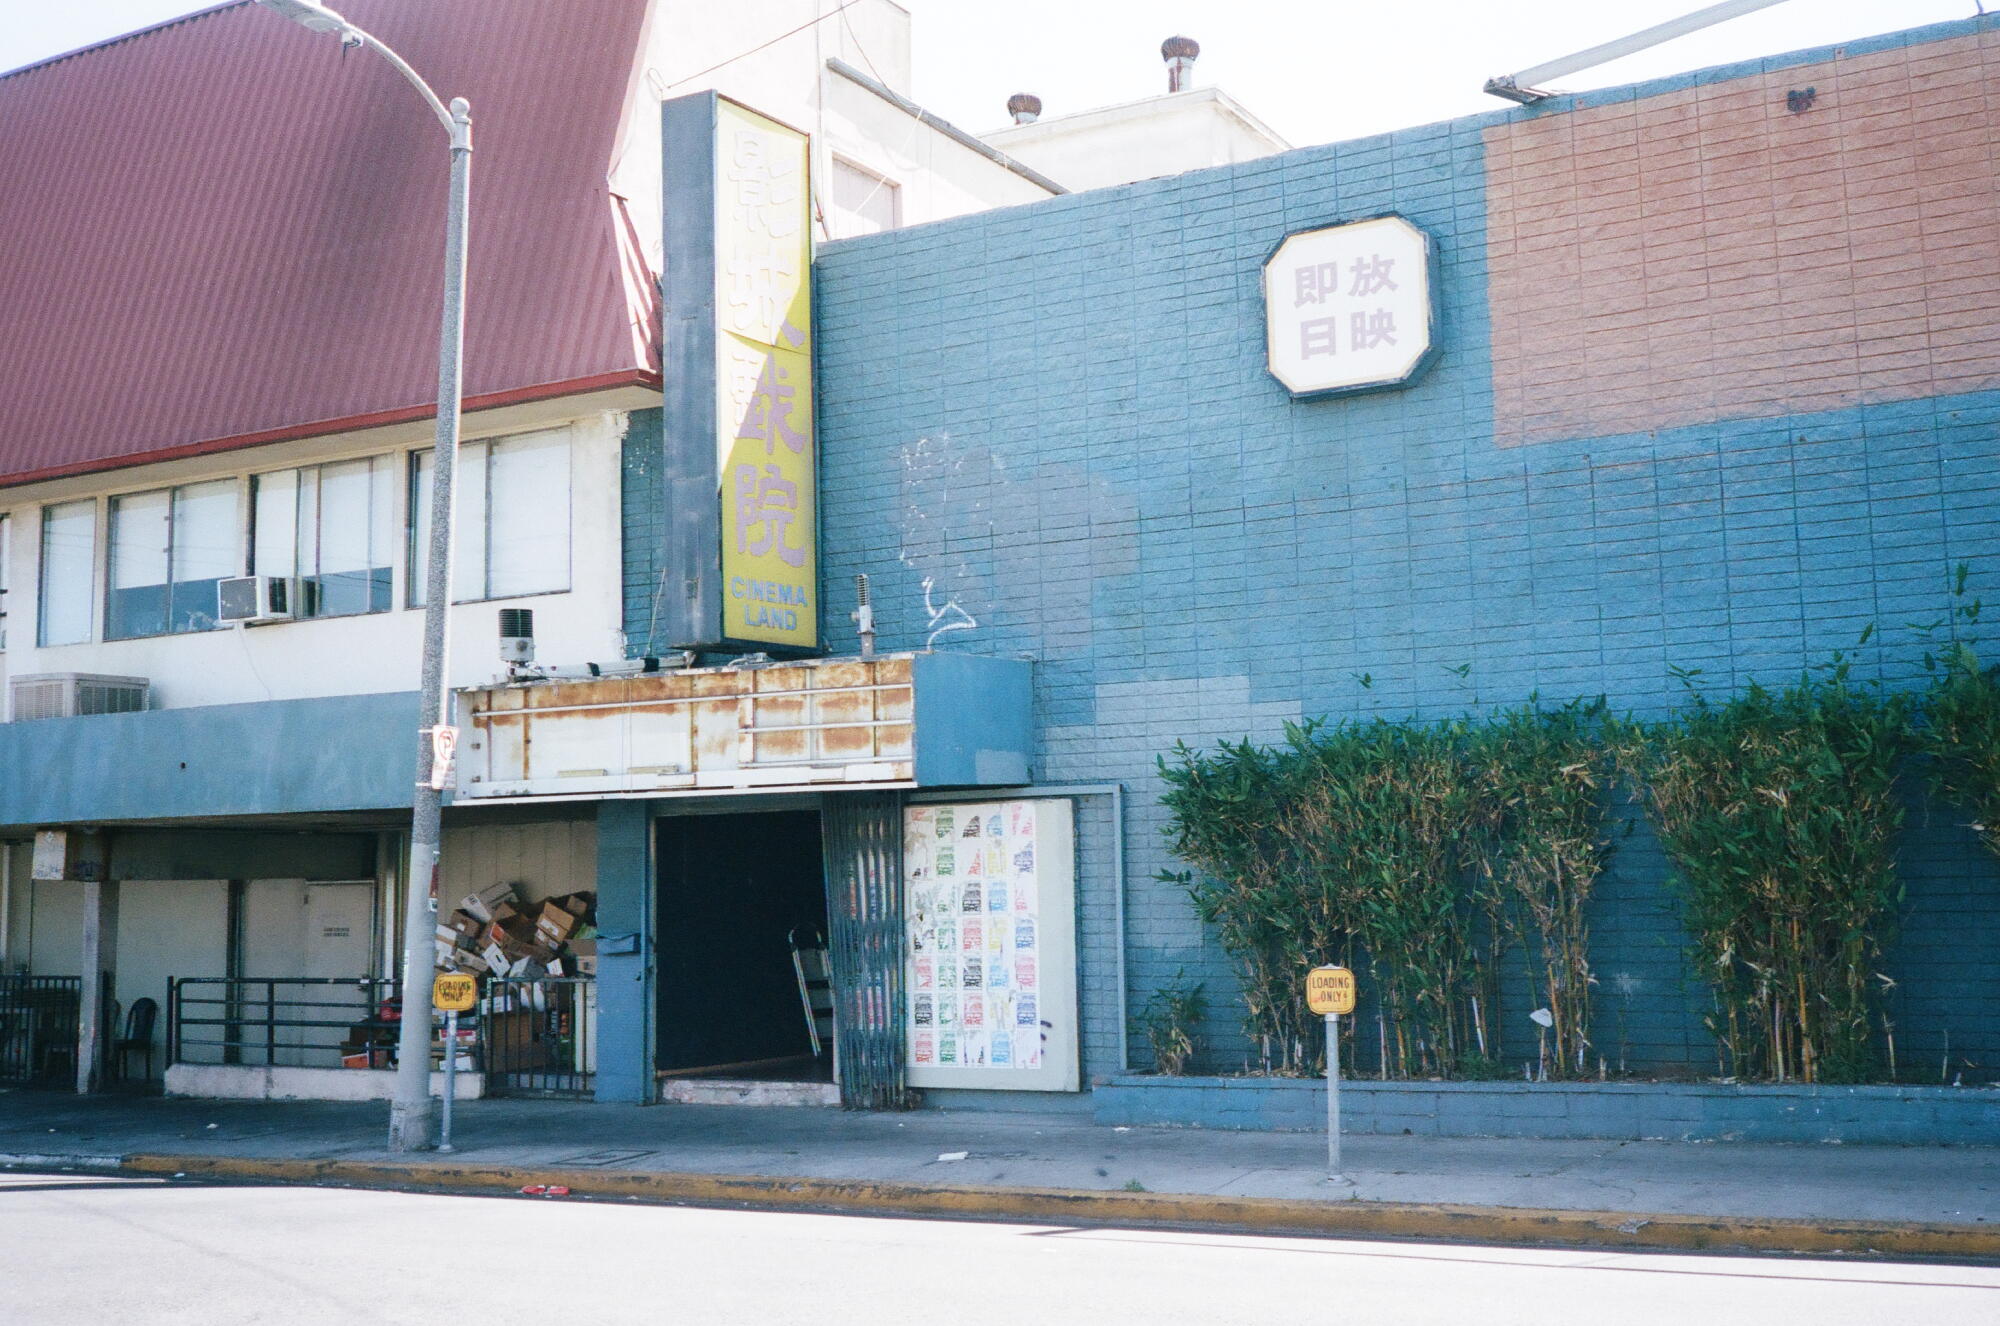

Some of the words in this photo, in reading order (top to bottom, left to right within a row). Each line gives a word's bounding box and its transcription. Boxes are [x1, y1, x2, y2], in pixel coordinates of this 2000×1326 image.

[731, 576, 808, 608] CINEMA
[743, 604, 798, 631] LAND
[1312, 976, 1350, 989] LOADING
[1320, 990, 1342, 1002] ONLY
